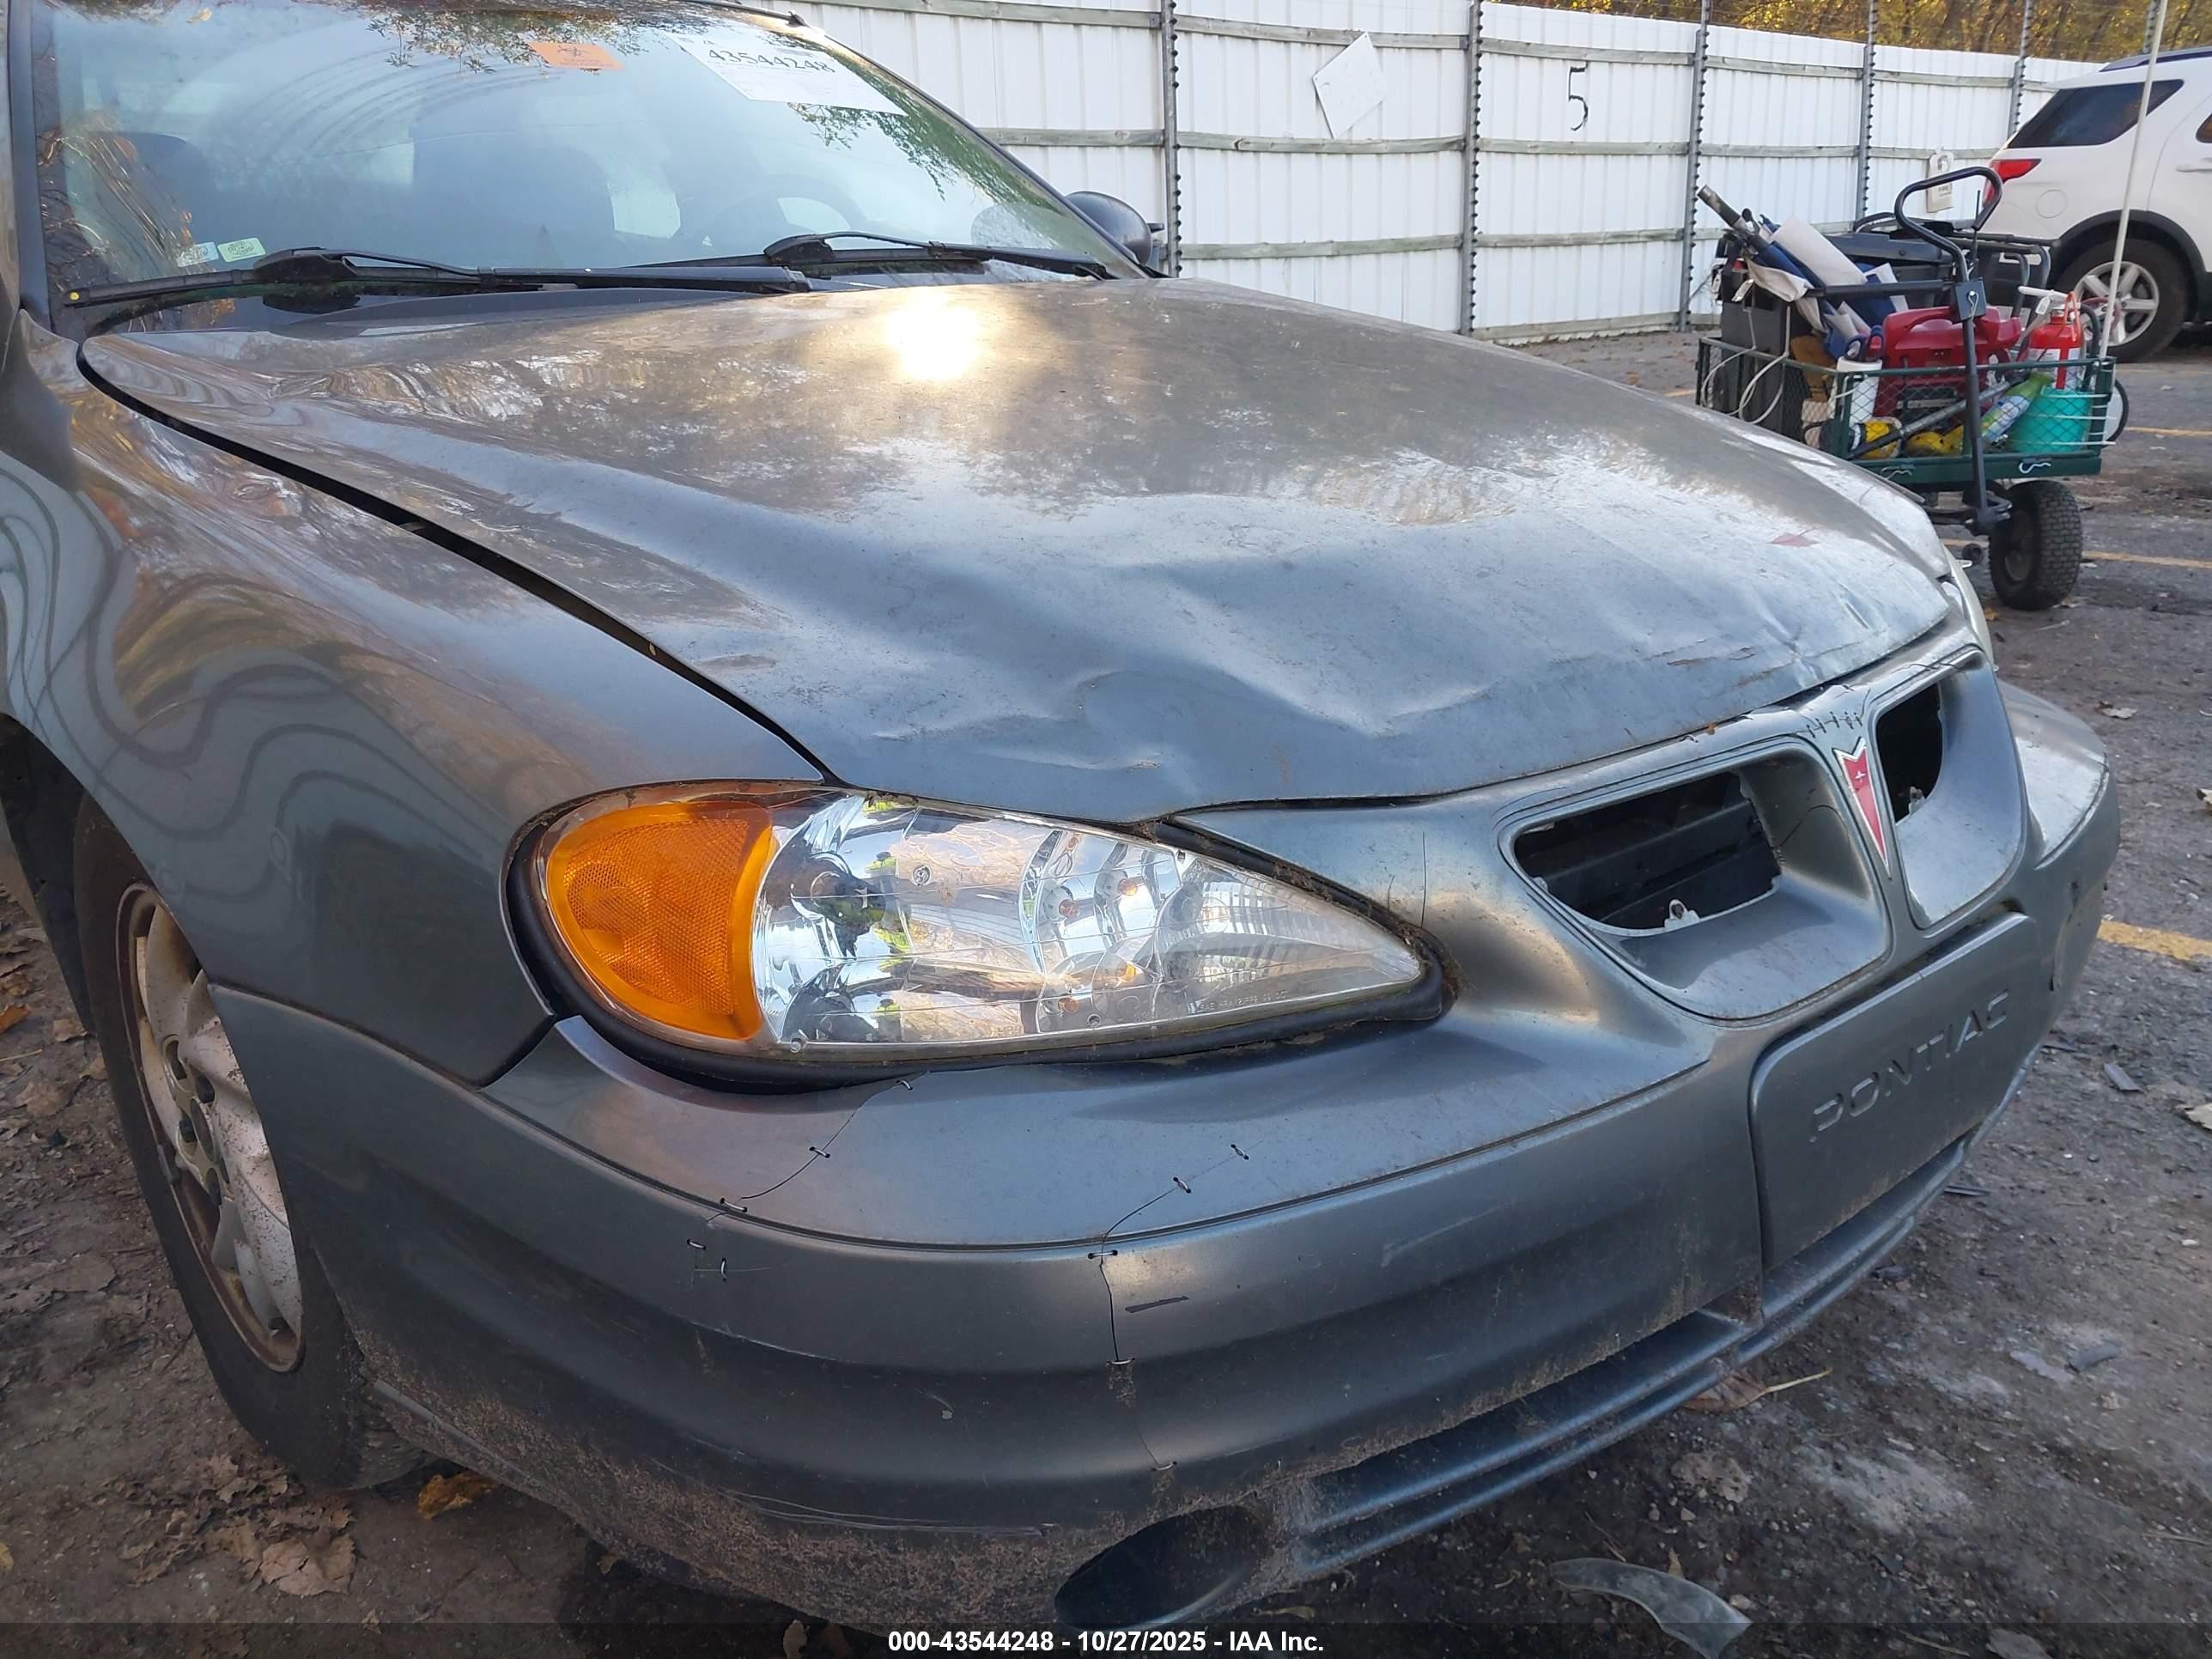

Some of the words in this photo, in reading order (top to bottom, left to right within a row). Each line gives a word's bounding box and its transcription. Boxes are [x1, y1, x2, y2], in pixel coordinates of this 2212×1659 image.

[709, 49, 836, 73] 43544248
[1568, 61, 1589, 131] 5
[1809, 988, 2008, 1143] PONTIAC
